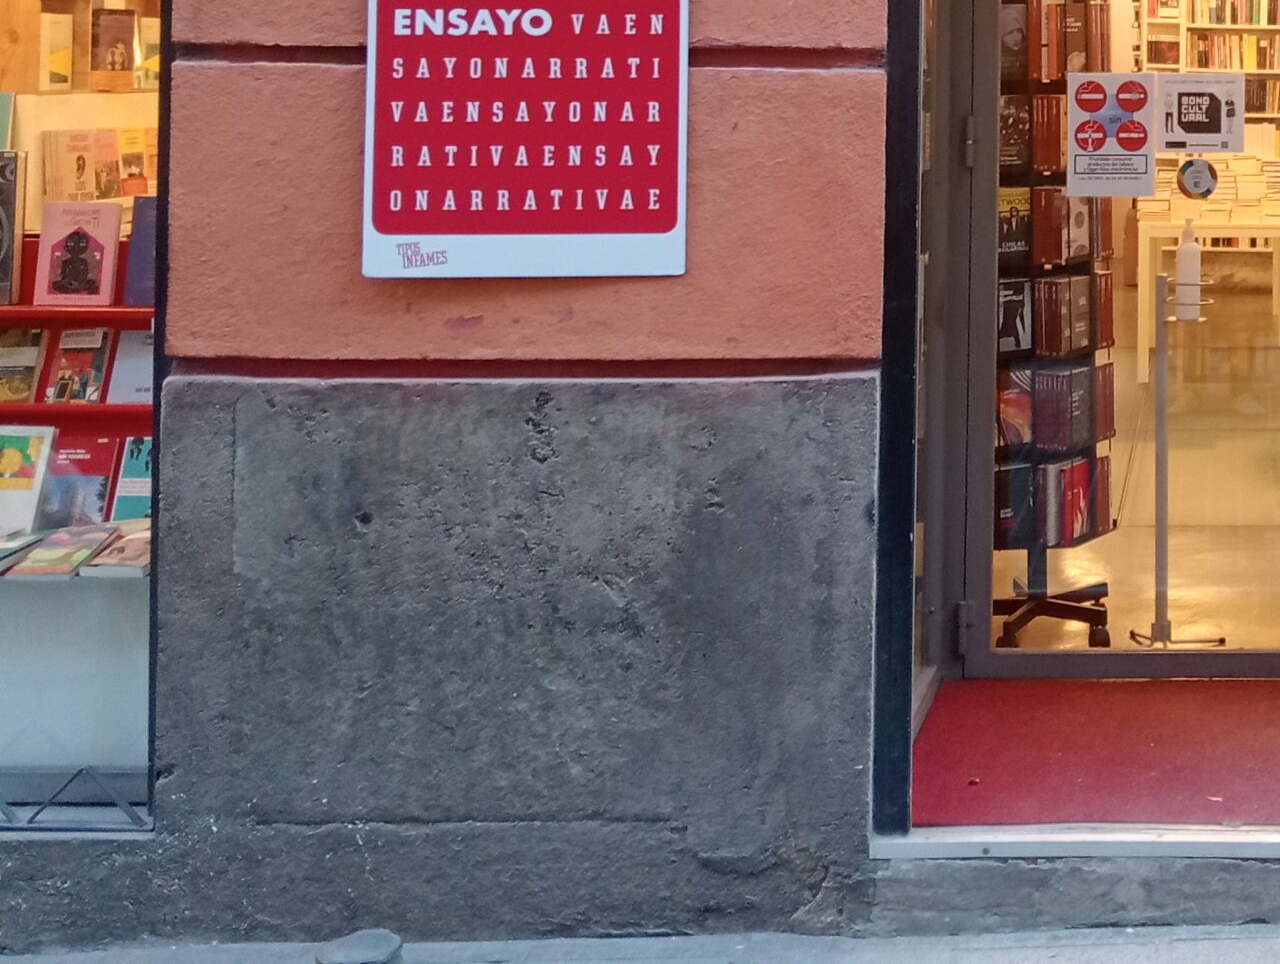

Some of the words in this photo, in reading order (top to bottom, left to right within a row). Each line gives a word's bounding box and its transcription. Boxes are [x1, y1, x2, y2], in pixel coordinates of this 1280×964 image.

[393, 8, 553, 36] ENSAYO
[1181, 96, 1210, 105] BONO
[1109, 115, 1122, 124] sin
[402, 250, 448, 269] INFAMES
